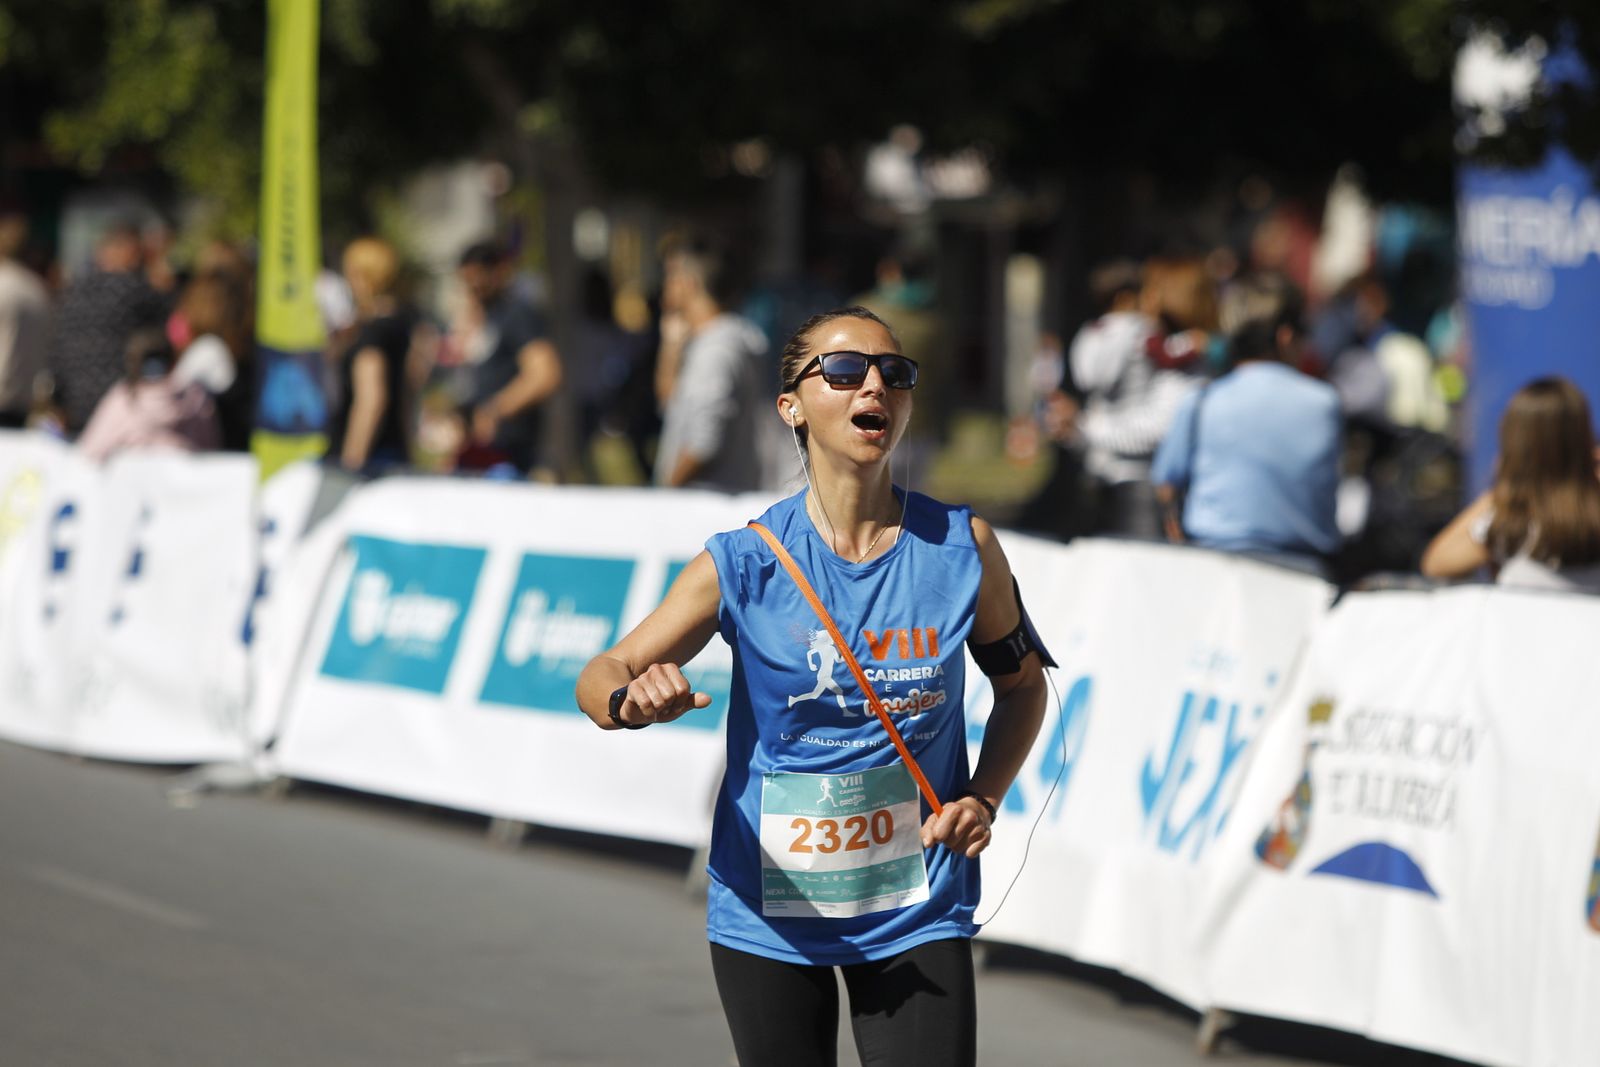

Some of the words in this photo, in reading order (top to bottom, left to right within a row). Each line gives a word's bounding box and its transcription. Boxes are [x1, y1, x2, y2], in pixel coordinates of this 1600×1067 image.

[863, 627, 939, 661] VIII
[863, 665, 944, 682] CARRERA
[853, 740, 866, 748] ES
[838, 774, 864, 787] VIII
[788, 809, 894, 854] 2320
